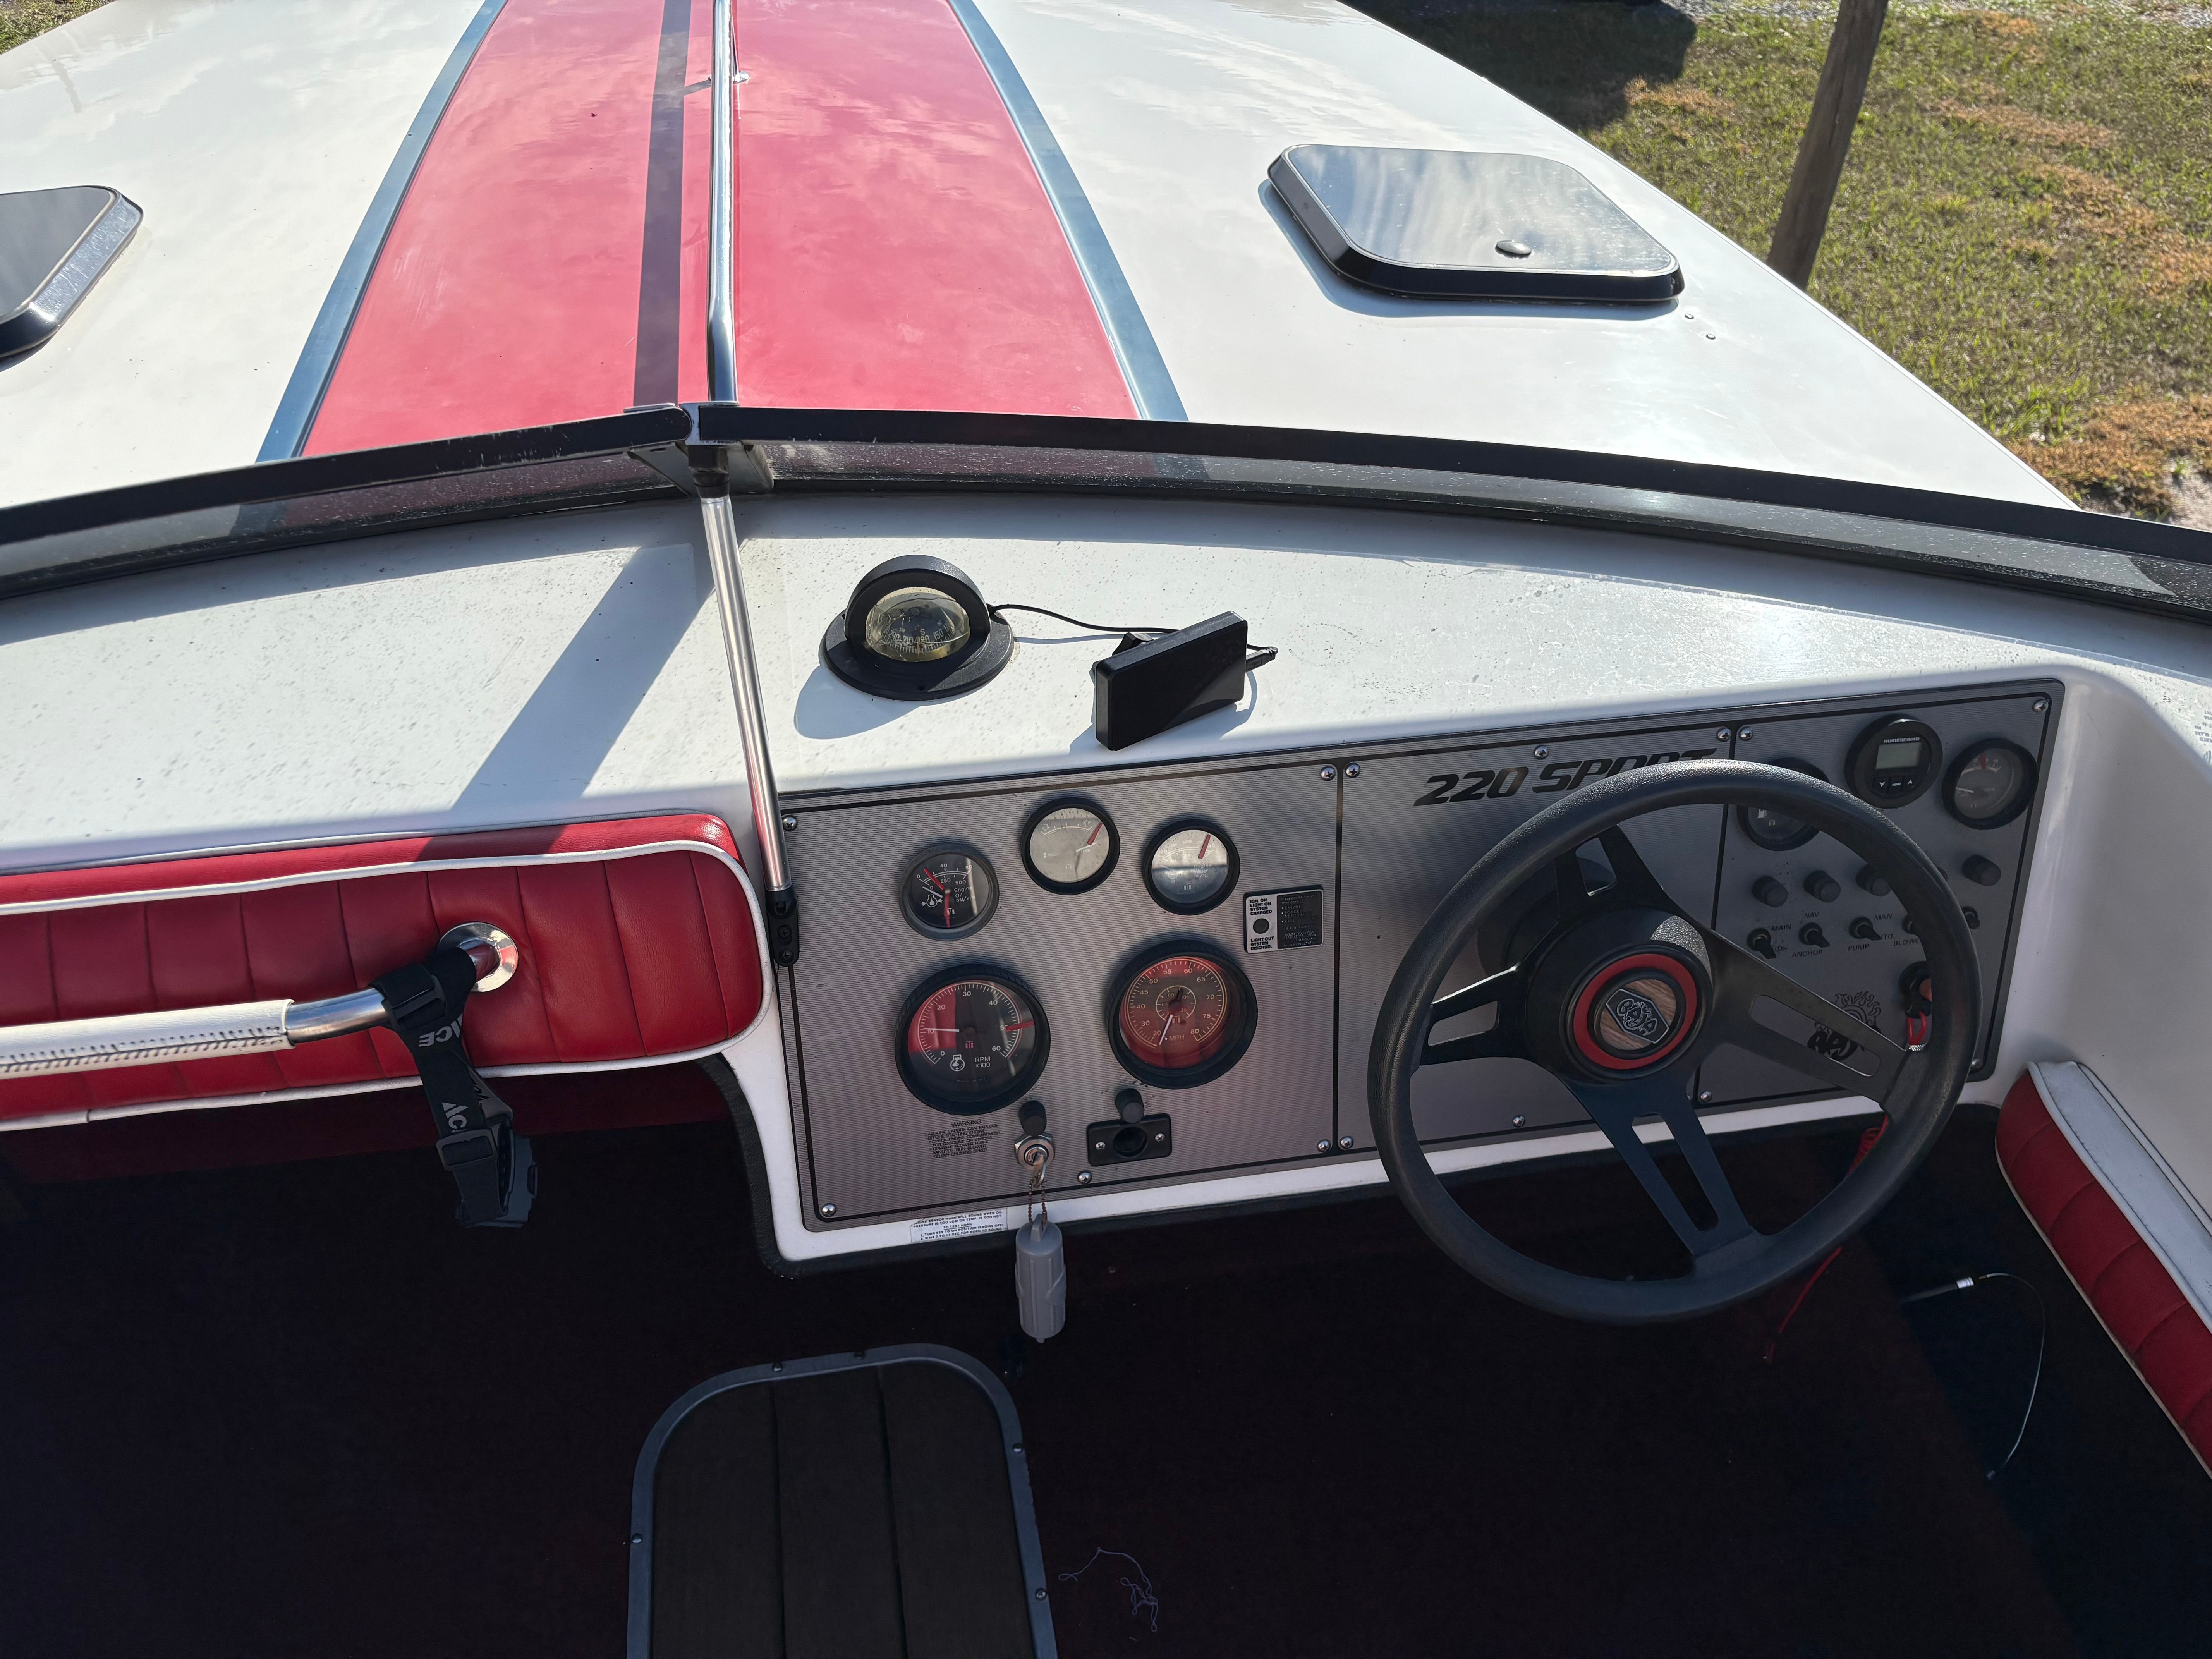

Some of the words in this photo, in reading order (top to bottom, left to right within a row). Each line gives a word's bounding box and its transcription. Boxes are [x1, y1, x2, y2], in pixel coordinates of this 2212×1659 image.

[933, 629, 944, 641] 150
[1413, 766, 1529, 807] 220
[1791, 949, 1823, 958] ANCHOR
